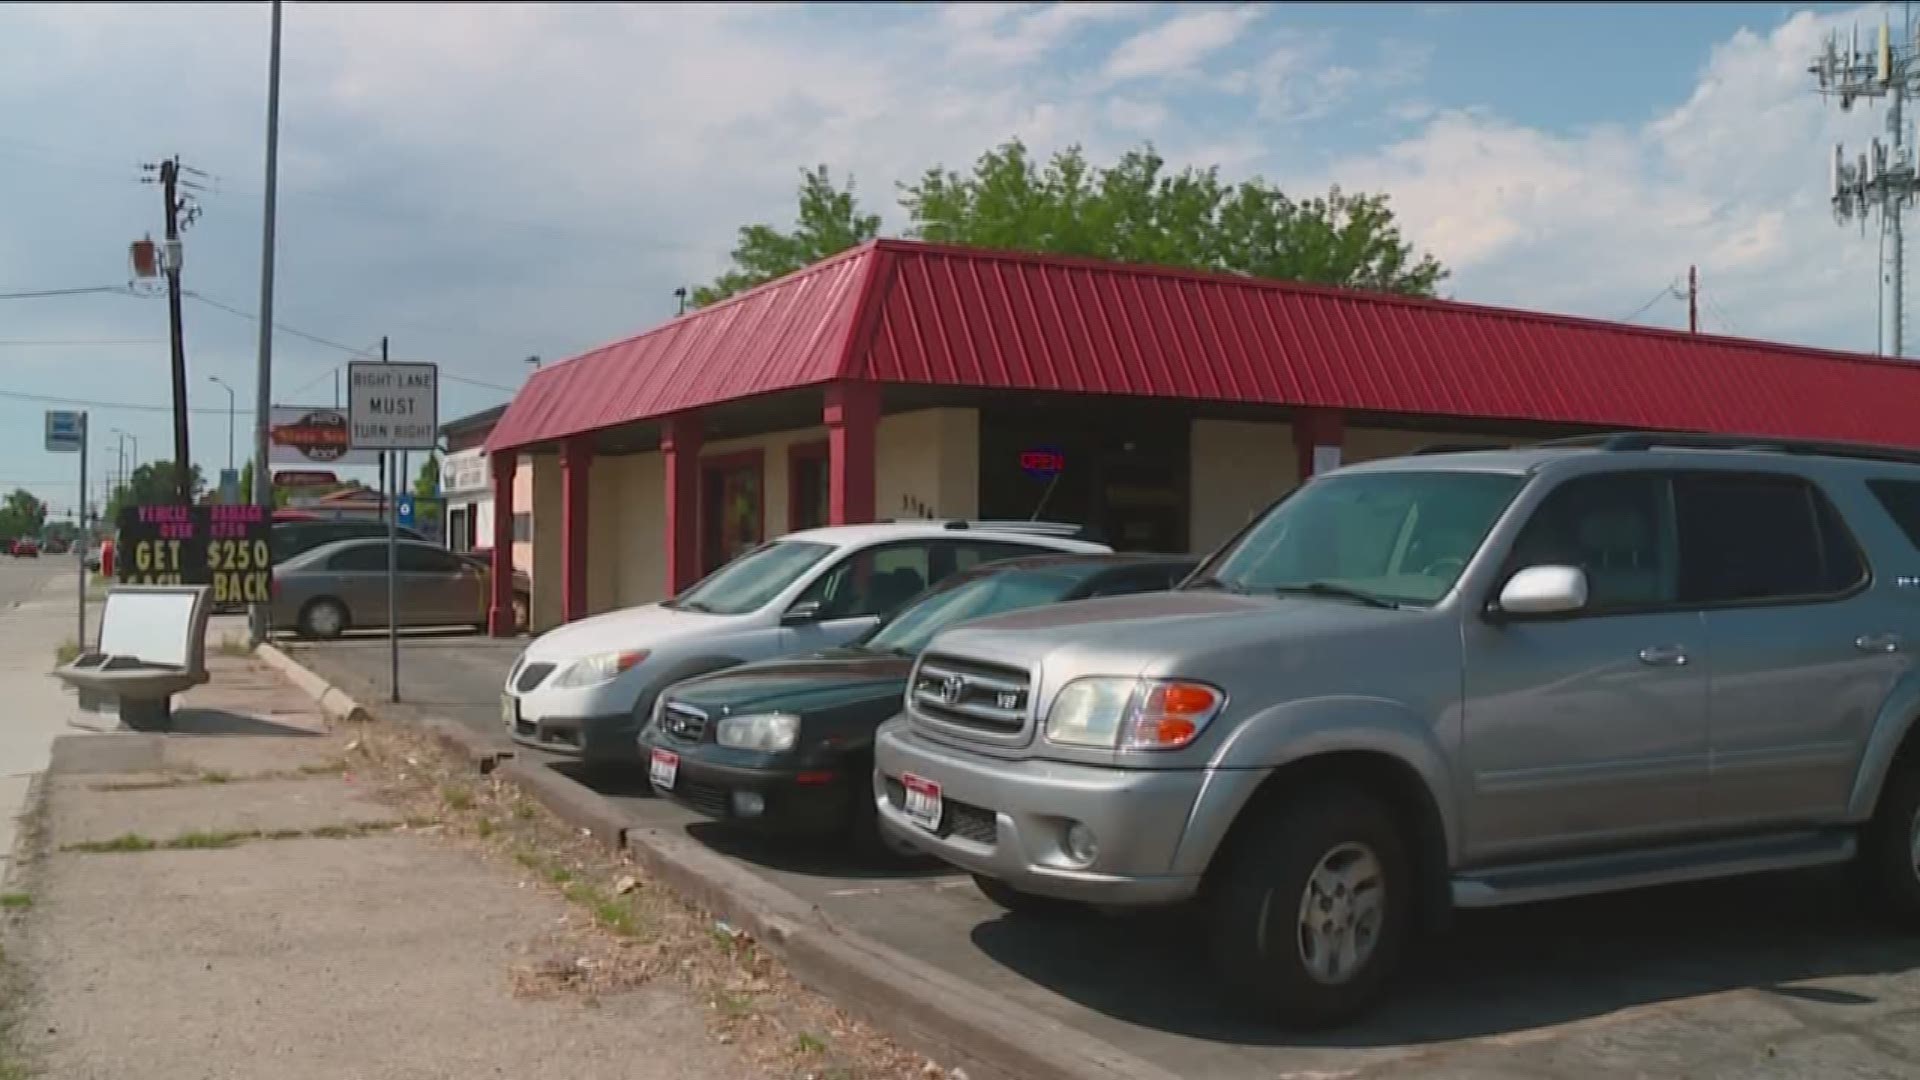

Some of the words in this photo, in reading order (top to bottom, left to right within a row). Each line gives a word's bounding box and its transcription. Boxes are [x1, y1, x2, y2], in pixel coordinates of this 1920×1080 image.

[353, 372, 391, 387] RIGHT
[398, 373, 430, 388] LANE
[370, 397, 416, 415] MUST
[354, 423, 387, 438] TURN
[394, 424, 432, 438] RIGHT
[1020, 452, 1065, 471] OPEN
[135, 539, 181, 571] GET
[207, 539, 269, 570] $250
[214, 572, 269, 602] BACK
[996, 691, 1018, 710] V8
